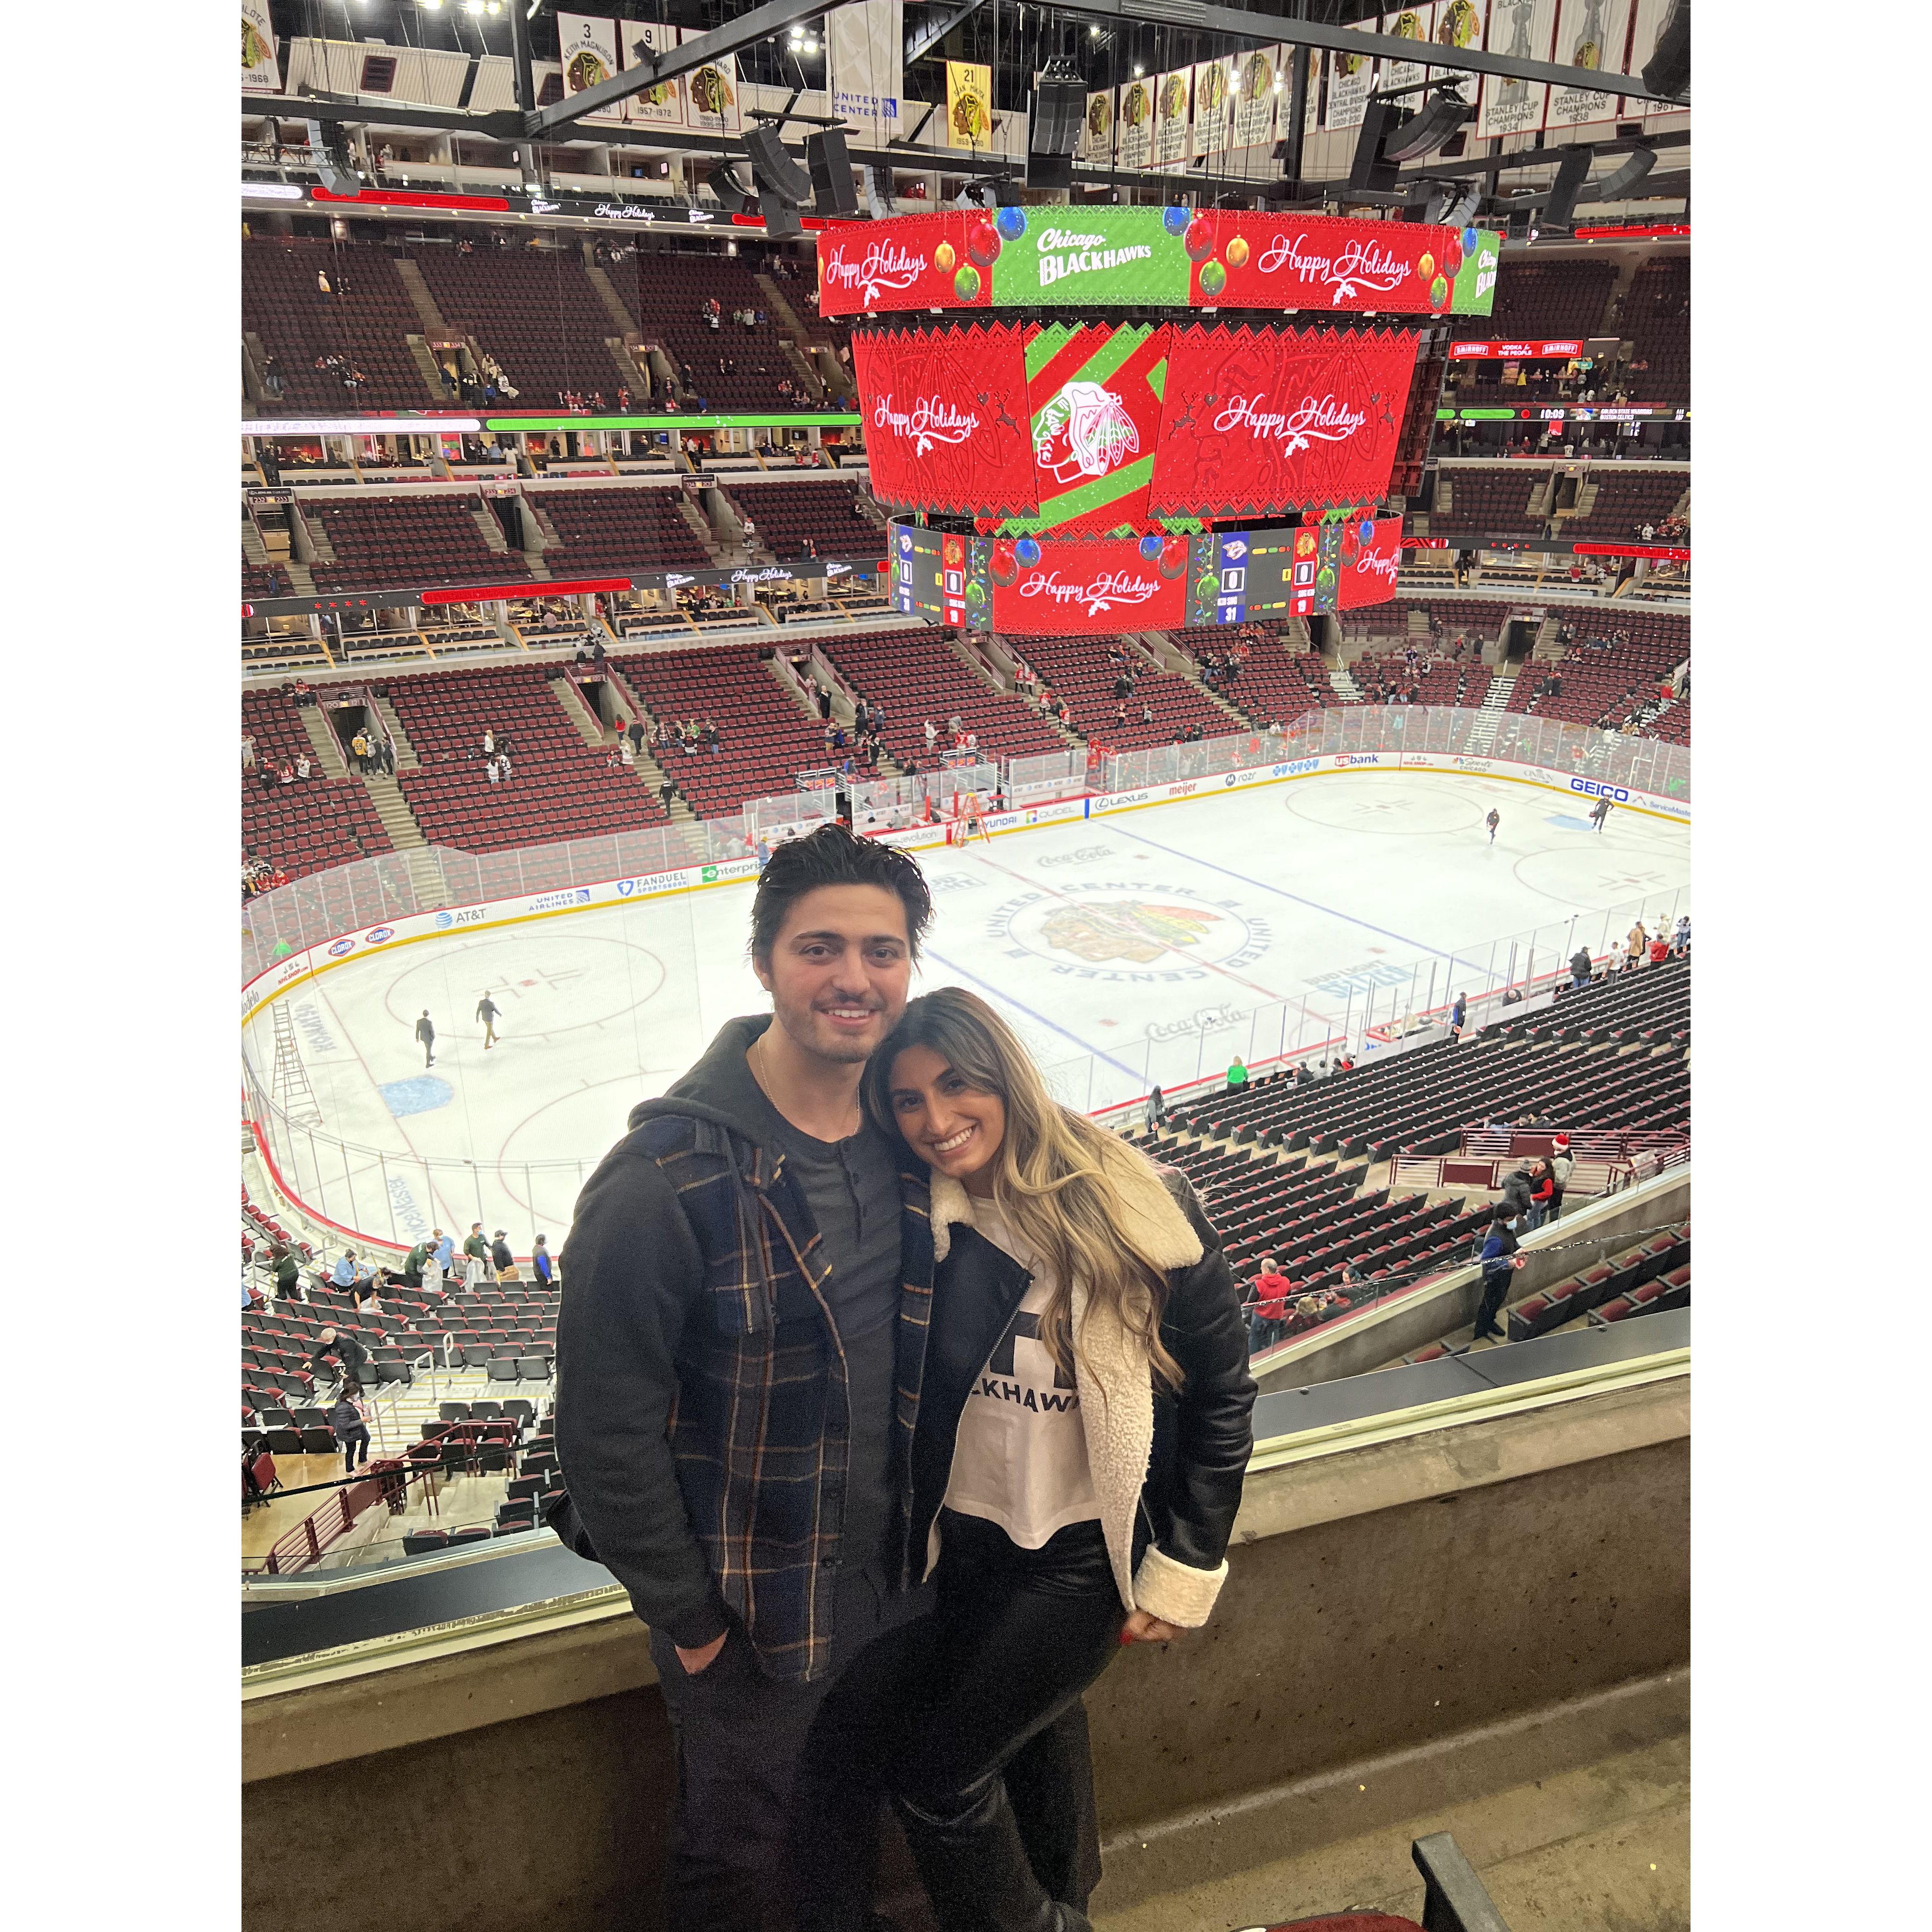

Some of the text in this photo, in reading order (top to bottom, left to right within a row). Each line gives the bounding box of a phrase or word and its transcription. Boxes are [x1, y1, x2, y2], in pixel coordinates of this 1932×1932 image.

[583, 23, 591, 38] 3
[645, 30, 652, 43] 9
[564, 42, 580, 58] KEITH
[580, 41, 614, 65] MAGNUSON
[964, 69, 974, 82] 21
[1391, 63, 1415, 75] CHICAGO
[1338, 77, 1361, 90] CHICAGO
[834, 91, 878, 104] UNITED
[1332, 86, 1366, 100] BLACKHAWKS
[1553, 92, 1611, 107] STANLEY CUP
[637, 106, 671, 117] 1957-1972
[834, 104, 878, 116] CENTER
[1333, 105, 1362, 118] CHAMPIONS
[1486, 102, 1539, 118] STANLEY CUP
[1556, 101, 1607, 116] CHAMPIONS
[1332, 115, 1361, 127] 2009-2010
[1488, 112, 1534, 126] CHAMPIONS
[1569, 112, 1589, 124] 1938
[1499, 122, 1518, 133] 1934
[594, 203, 656, 219] Happy Holidays
[1037, 228, 1106, 252] Chicago
[827, 238, 928, 289] Happy Holidays
[1039, 245, 1151, 287] BLACKHAWKS
[1258, 234, 1412, 286] Happy Holidays
[1456, 345, 1486, 354] SMIRNOFF
[1544, 344, 1576, 352] SMIRNOFF
[874, 394, 979, 437] Happy Holidays
[1214, 393, 1366, 438] Happy Holidays
[1540, 409, 1565, 420] 10:09
[731, 567, 793, 583] Happy Holidays
[950, 573, 957, 592] 0
[1229, 564, 1309, 589] 0 0
[1020, 570, 1161, 603] Happy Holidays
[1225, 607, 1237, 621] 31
[1169, 782, 1197, 796] meijer
[1570, 777, 1629, 802] GEICO
[1110, 793, 1149, 806] LEXUS
[1039, 807, 1076, 818] QUIDEL
[901, 830, 938, 843] revolution
[1036, 845, 1117, 868] Coca-Cola
[637, 872, 687, 887] FANDUEL
[638, 880, 687, 893] SPORTSBOOK
[1060, 881, 1197, 897] CENTER
[529, 898, 574, 911] AIRLINES
[537, 893, 573, 904] UNITED
[457, 908, 486, 923] AT&T
[987, 892, 1043, 938] UNITED
[368, 930, 391, 942] CLOROX
[1228, 916, 1273, 969] UNITED
[331, 941, 353, 955] CLOROX
[1052, 964, 1208, 983] CENTER
[1144, 1002, 1250, 1043] Coca-Cola
[972, 1378, 1080, 1413] KHAW
